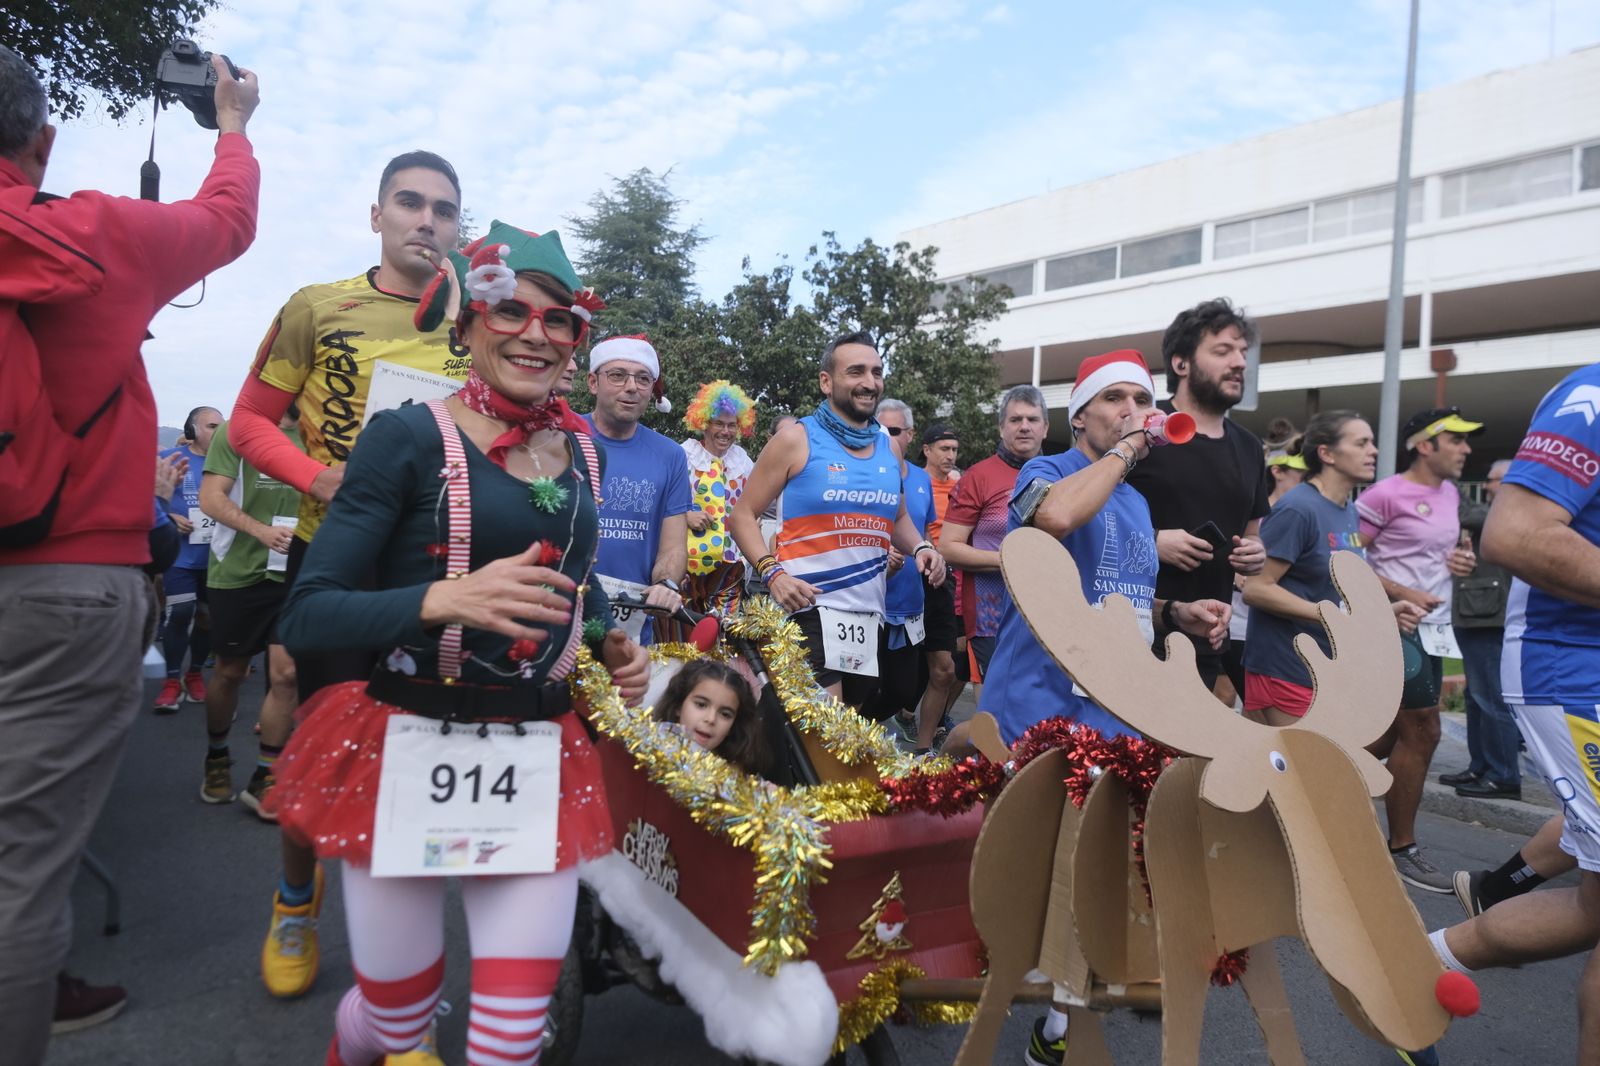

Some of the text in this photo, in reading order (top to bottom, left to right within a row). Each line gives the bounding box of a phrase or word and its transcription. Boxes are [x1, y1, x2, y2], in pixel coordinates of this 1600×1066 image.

[406, 373, 440, 386] SILVESTRE
[320, 328, 365, 466] ORDOBA
[822, 489, 898, 505] enerplus
[834, 516, 887, 532] Maratón
[838, 535, 881, 547] Lucena
[1093, 578, 1116, 593] SAN
[837, 622, 866, 645] 313
[430, 763, 517, 804] 914
